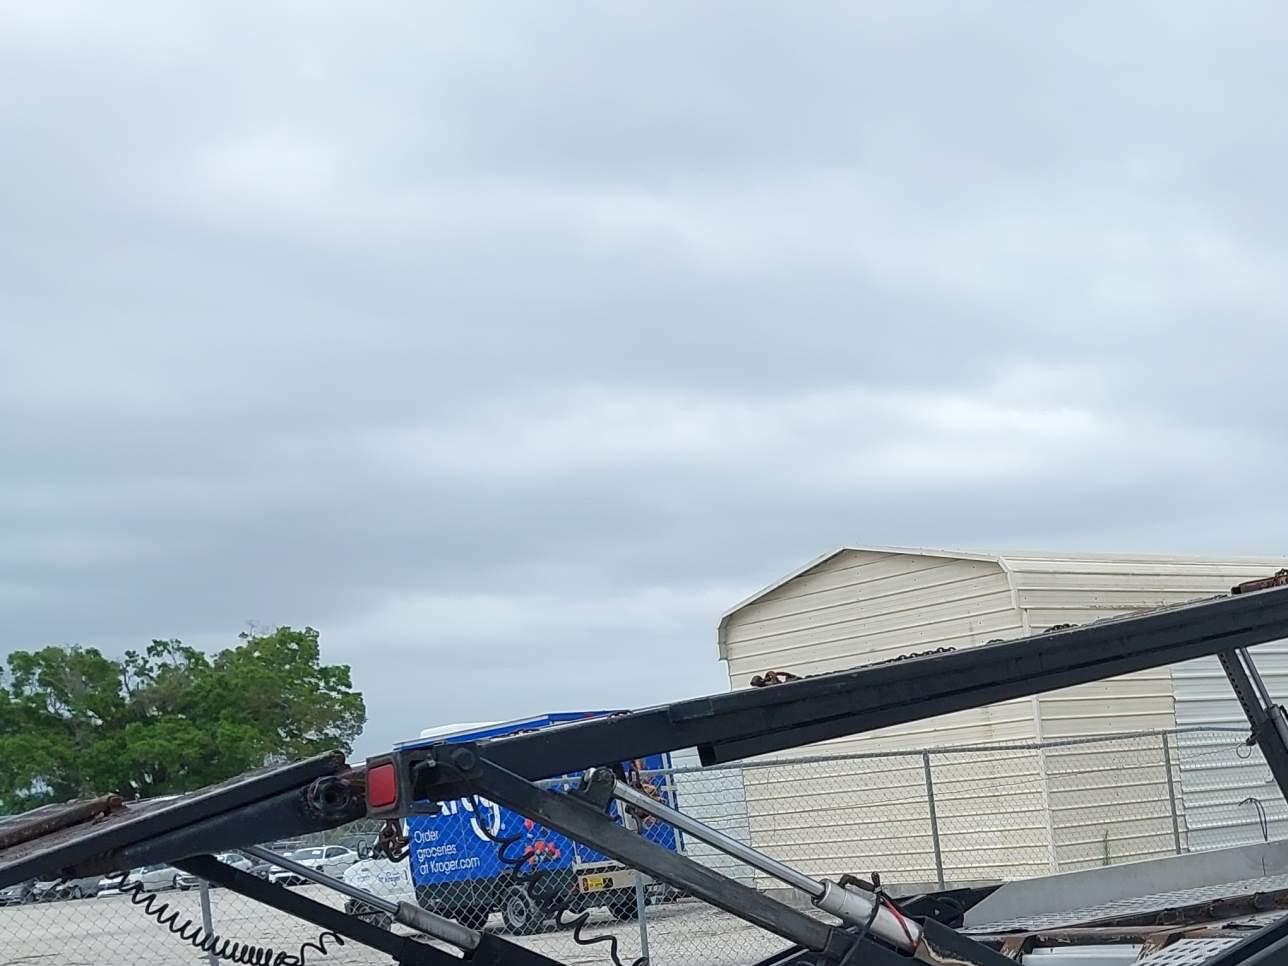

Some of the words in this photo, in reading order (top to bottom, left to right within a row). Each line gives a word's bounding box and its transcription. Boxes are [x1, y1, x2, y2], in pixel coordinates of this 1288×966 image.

[414, 830, 439, 843] Order
[416, 843, 457, 862] groceries
[420, 862, 429, 875] at
[430, 857, 481, 875] Kroger.com
